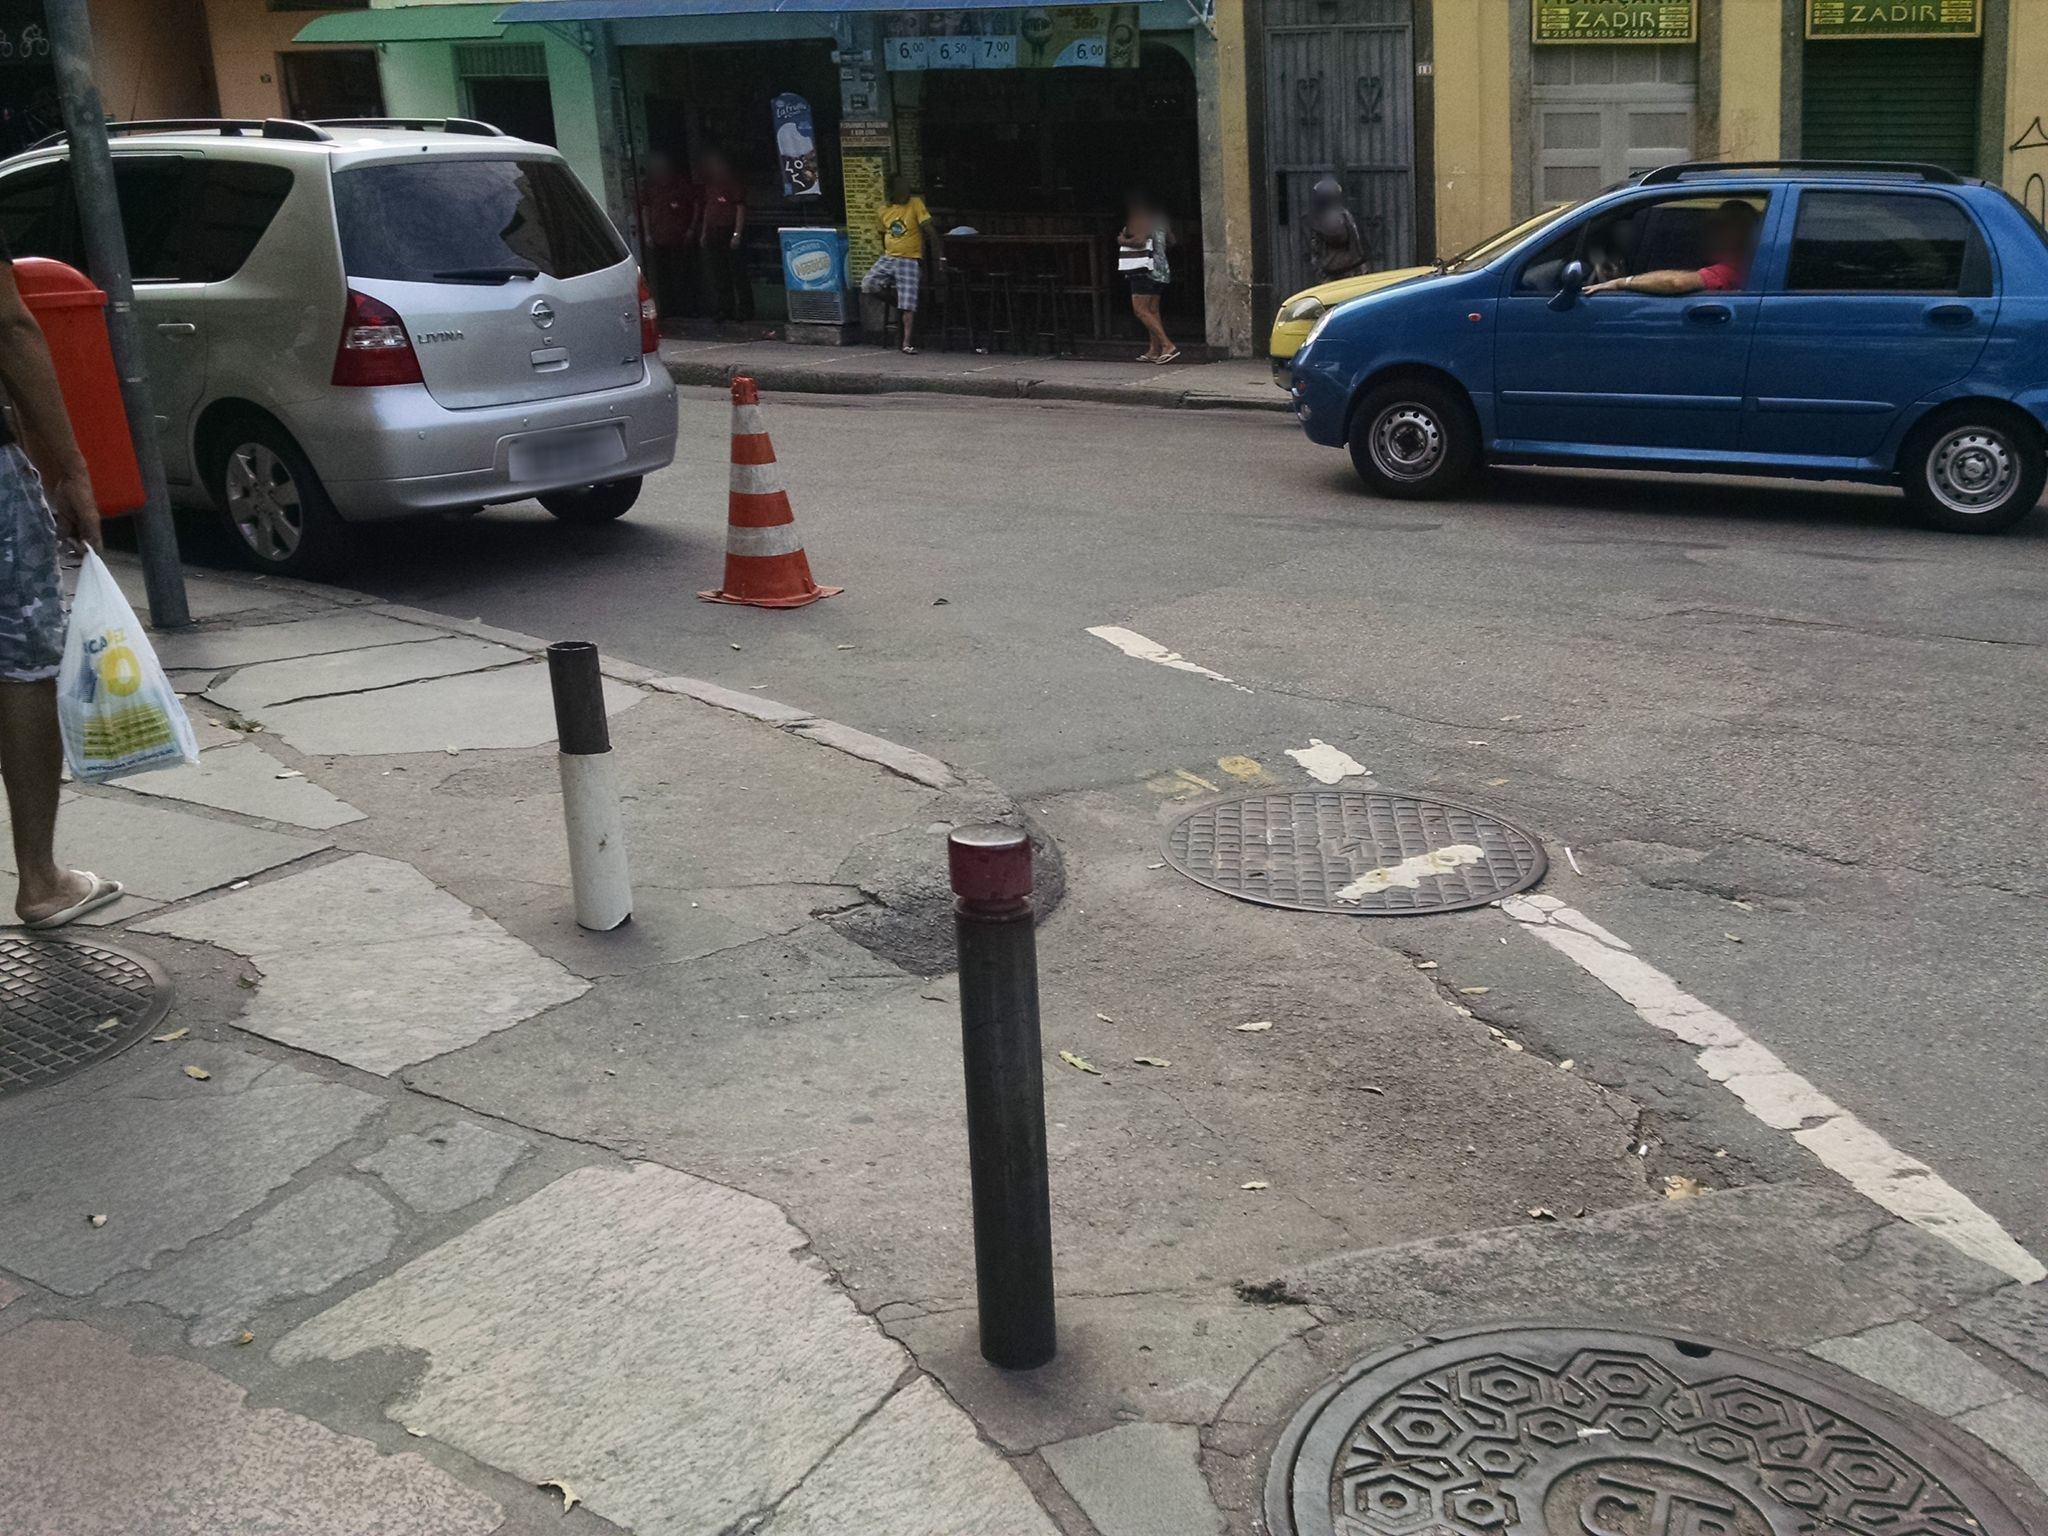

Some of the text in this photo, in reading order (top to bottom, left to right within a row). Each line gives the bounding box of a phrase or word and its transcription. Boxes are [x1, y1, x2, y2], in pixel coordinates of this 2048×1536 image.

[1575, 11, 1656, 28] ZADIR
[1850, 5, 1937, 22] ZADIR
[416, 329, 465, 345] LIVINA
